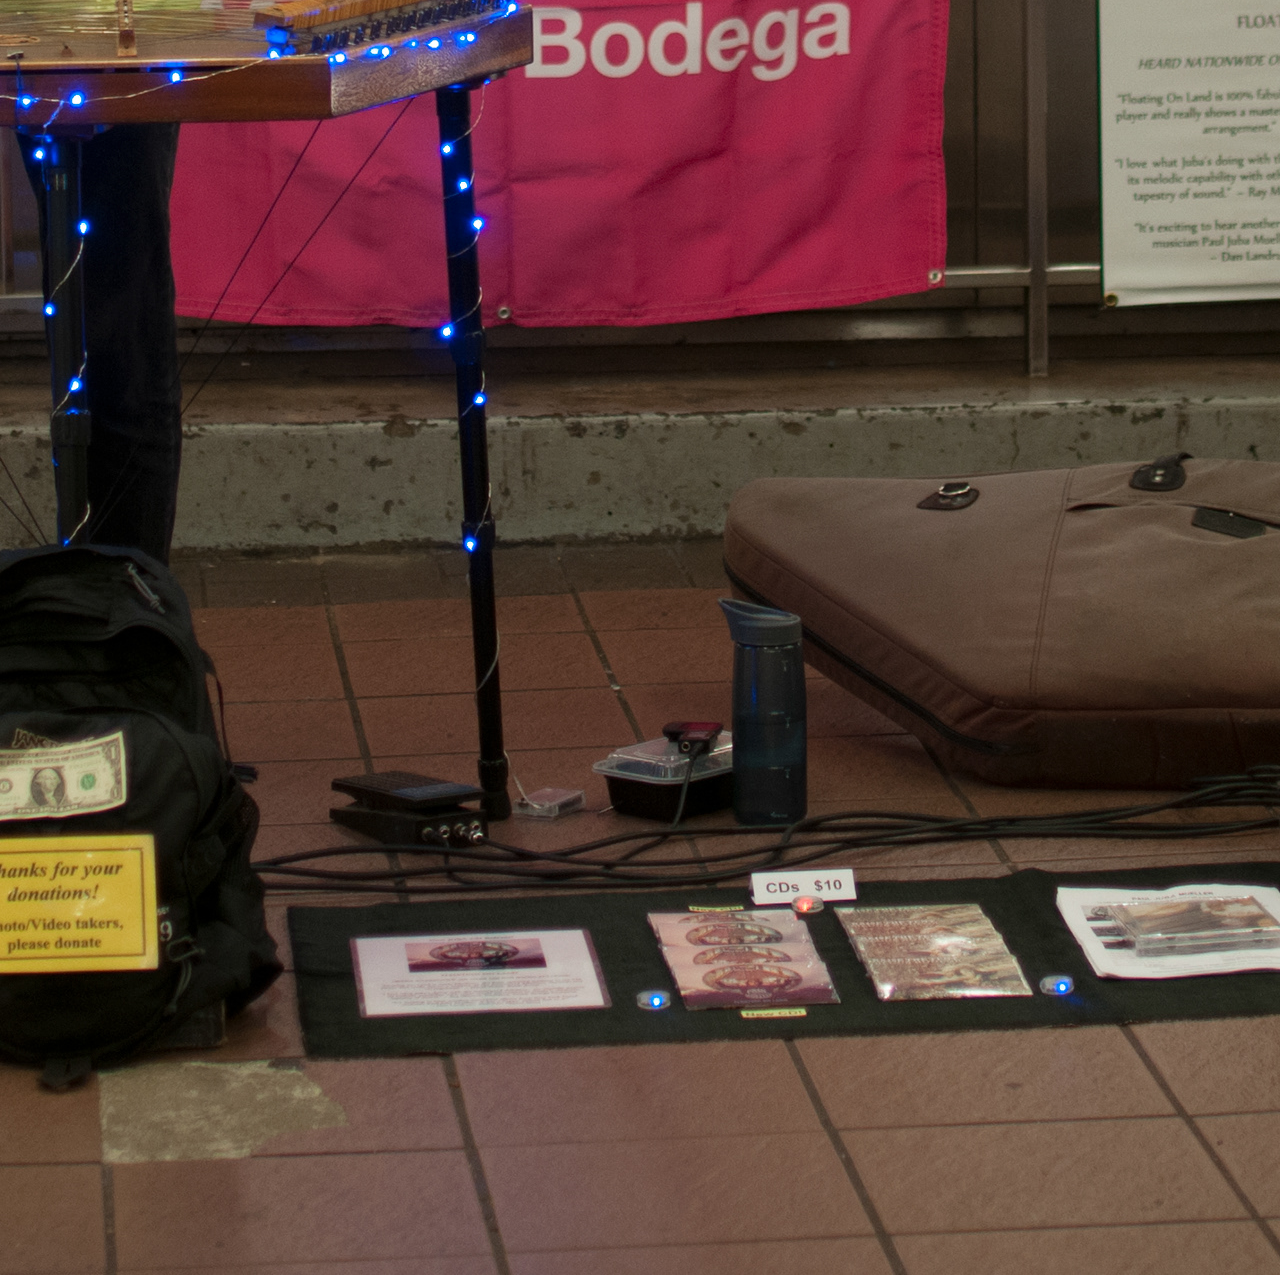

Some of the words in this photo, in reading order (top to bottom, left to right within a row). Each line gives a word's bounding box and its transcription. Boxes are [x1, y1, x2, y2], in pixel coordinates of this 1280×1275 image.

[524, 1, 850, 81] Bodega
[1138, 58, 1182, 70] HEARD
[1185, 55, 1265, 68] NATIONWIDE
[50, 861, 78, 881] for
[81, 863, 122, 880] your
[7, 885, 100, 903] donations!
[766, 881, 800, 893] CDs
[814, 879, 843, 892] $10
[76, 917, 124, 931] takers,
[8, 939, 50, 954] please
[54, 938, 102, 949] donate
